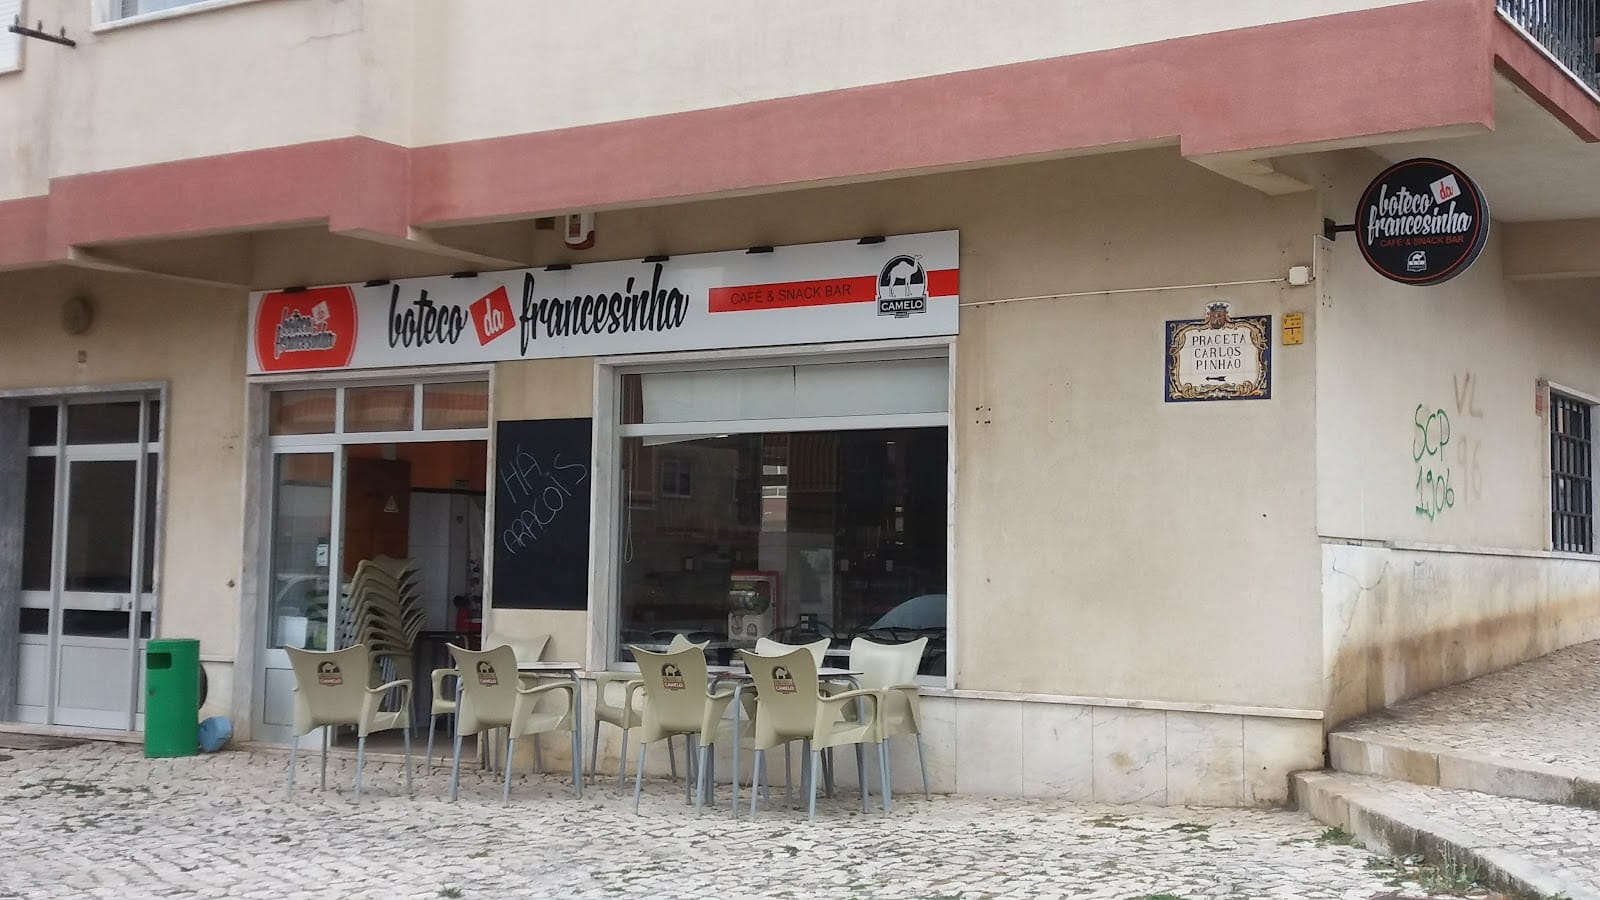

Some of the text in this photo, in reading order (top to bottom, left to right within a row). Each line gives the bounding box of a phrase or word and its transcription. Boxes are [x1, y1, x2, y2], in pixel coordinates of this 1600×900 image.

[1379, 181, 1453, 216] boteco da
[1368, 201, 1472, 246] francesinha
[1446, 234, 1464, 244] BAR
[389, 263, 689, 356] boteco da francesinha
[731, 284, 851, 305] CAFÉ & SNACK BAR
[881, 299, 923, 311] CAMELO
[1192, 333, 1246, 346] PRACETA
[1194, 346, 1241, 358] CARLOS
[1413, 404, 1450, 462] SCP
[500, 443, 541, 503] HÁ
[1415, 465, 1454, 521] 1906
